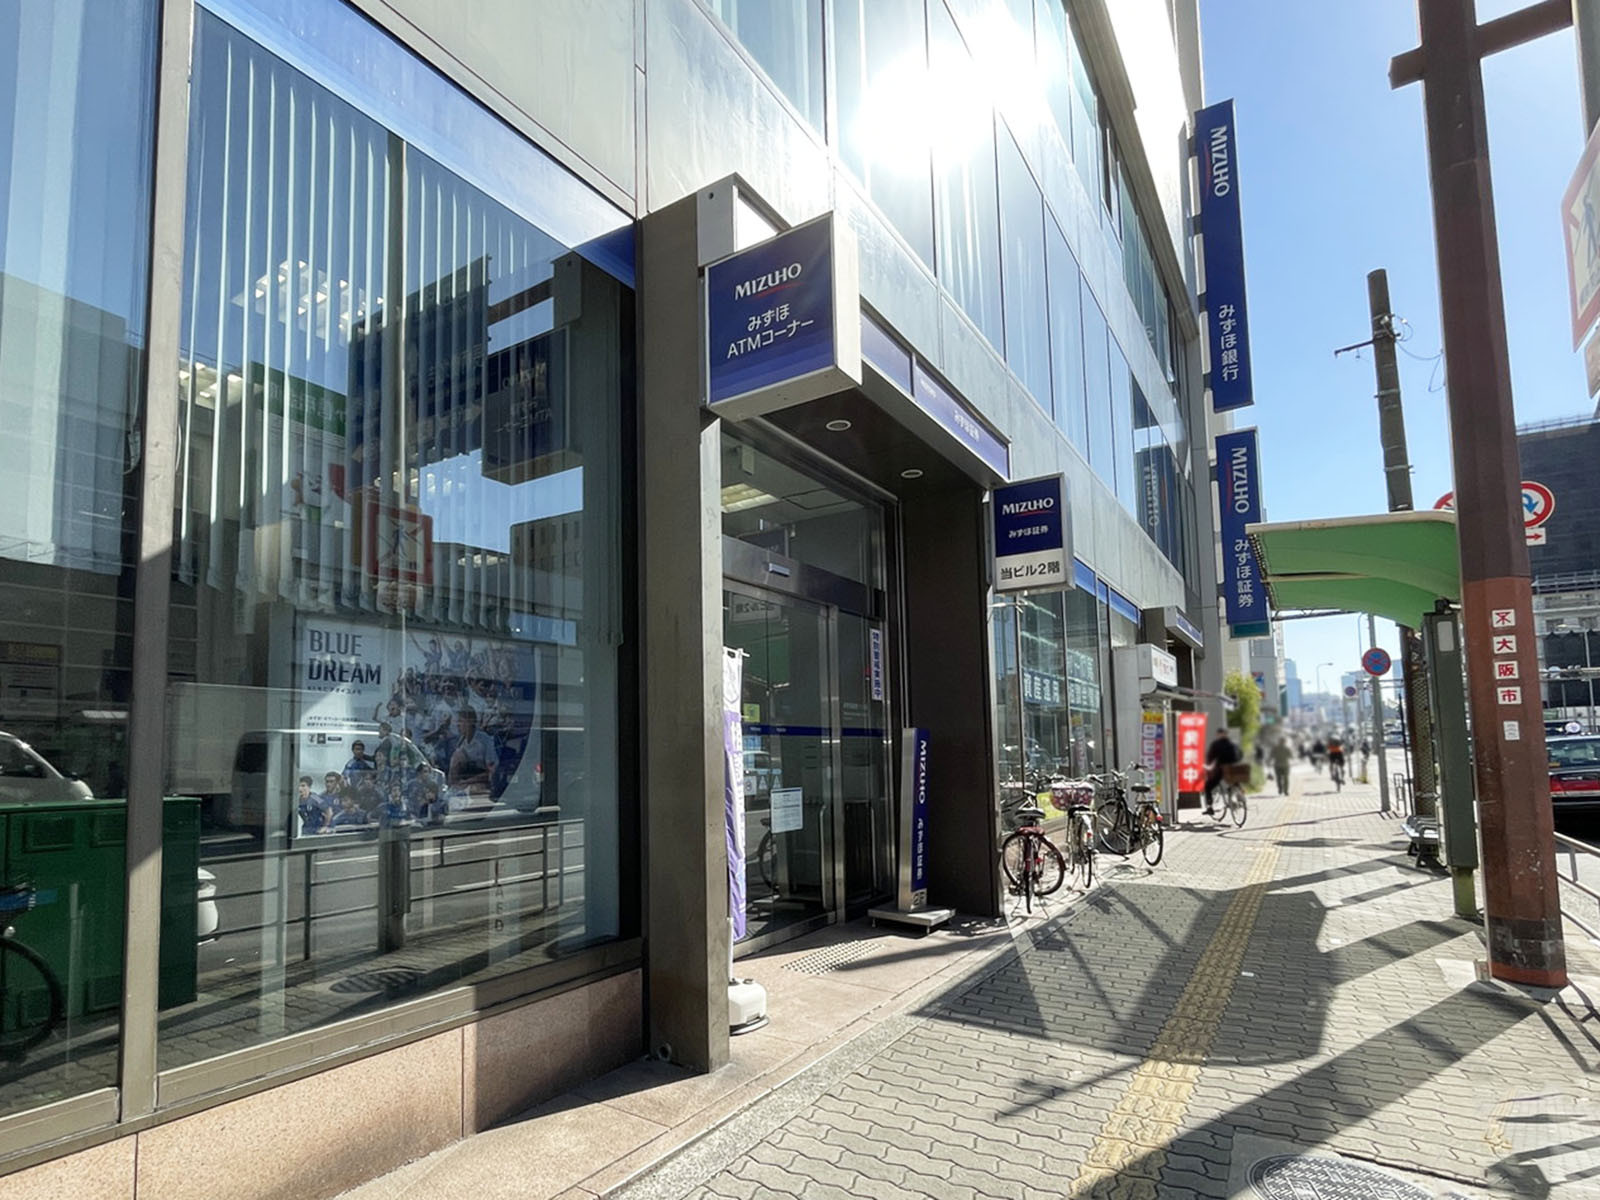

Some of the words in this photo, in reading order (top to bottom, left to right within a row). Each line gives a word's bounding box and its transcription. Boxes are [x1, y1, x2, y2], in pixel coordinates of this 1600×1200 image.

[1210, 125, 1230, 197] MIZUHO
[734, 262, 802, 301] MIZUHO
[747, 303, 791, 332] みずほ
[726, 319, 815, 359] ATMコーナー
[1218, 304, 1240, 381] みずほ銀行
[1231, 447, 1250, 514] MIZUHO
[1002, 497, 1054, 515] MIZUHO
[1008, 525, 1049, 539] みずほ証券
[1000, 560, 1061, 580] 当ビル2階
[1234, 538, 1254, 608] みずほ証券
[308, 629, 362, 657] BLUE
[307, 658, 382, 685] DREAM
[1023, 673, 1060, 703] 資産運用
[919, 739, 927, 804] MIZUHO
